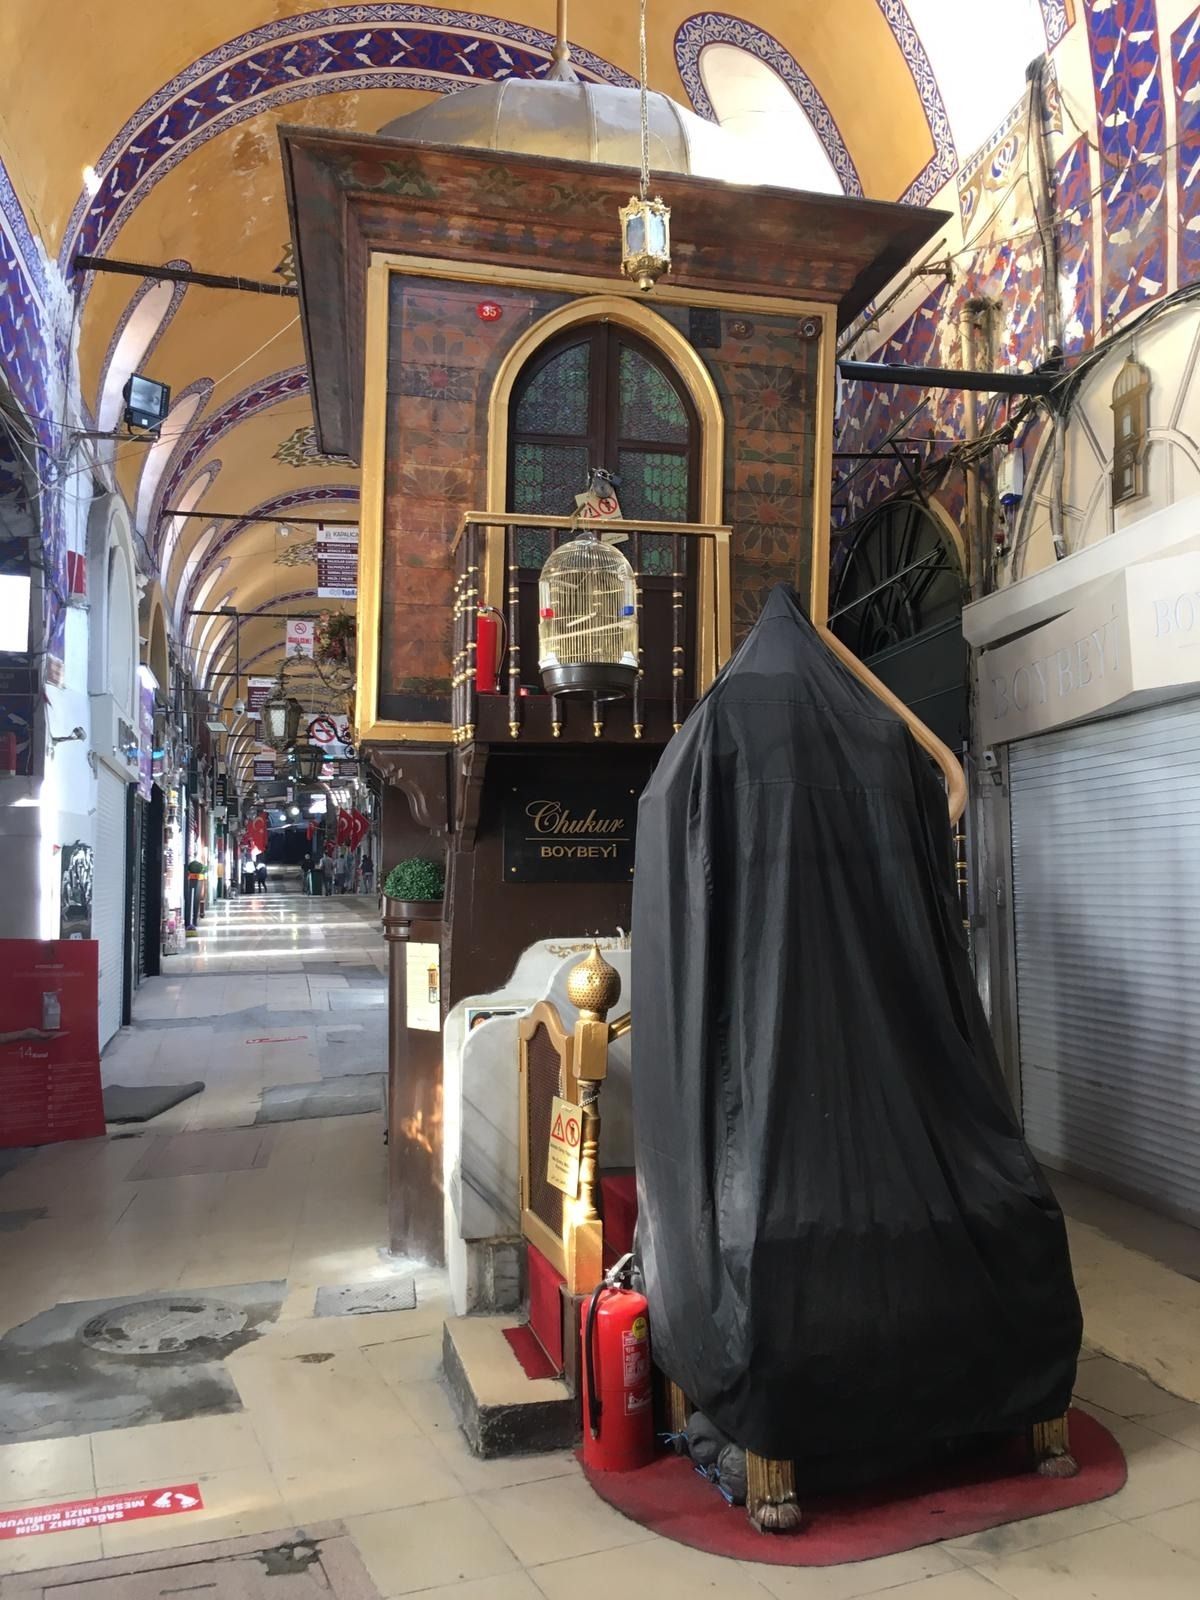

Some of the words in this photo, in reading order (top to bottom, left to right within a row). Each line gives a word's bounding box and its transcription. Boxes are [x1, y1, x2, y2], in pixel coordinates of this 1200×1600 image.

[482, 306, 497, 317] 35
[1153, 592, 1200, 638] BO
[525, 800, 625, 834] Chukur
[541, 844, 618, 858] BOYBEYİ
